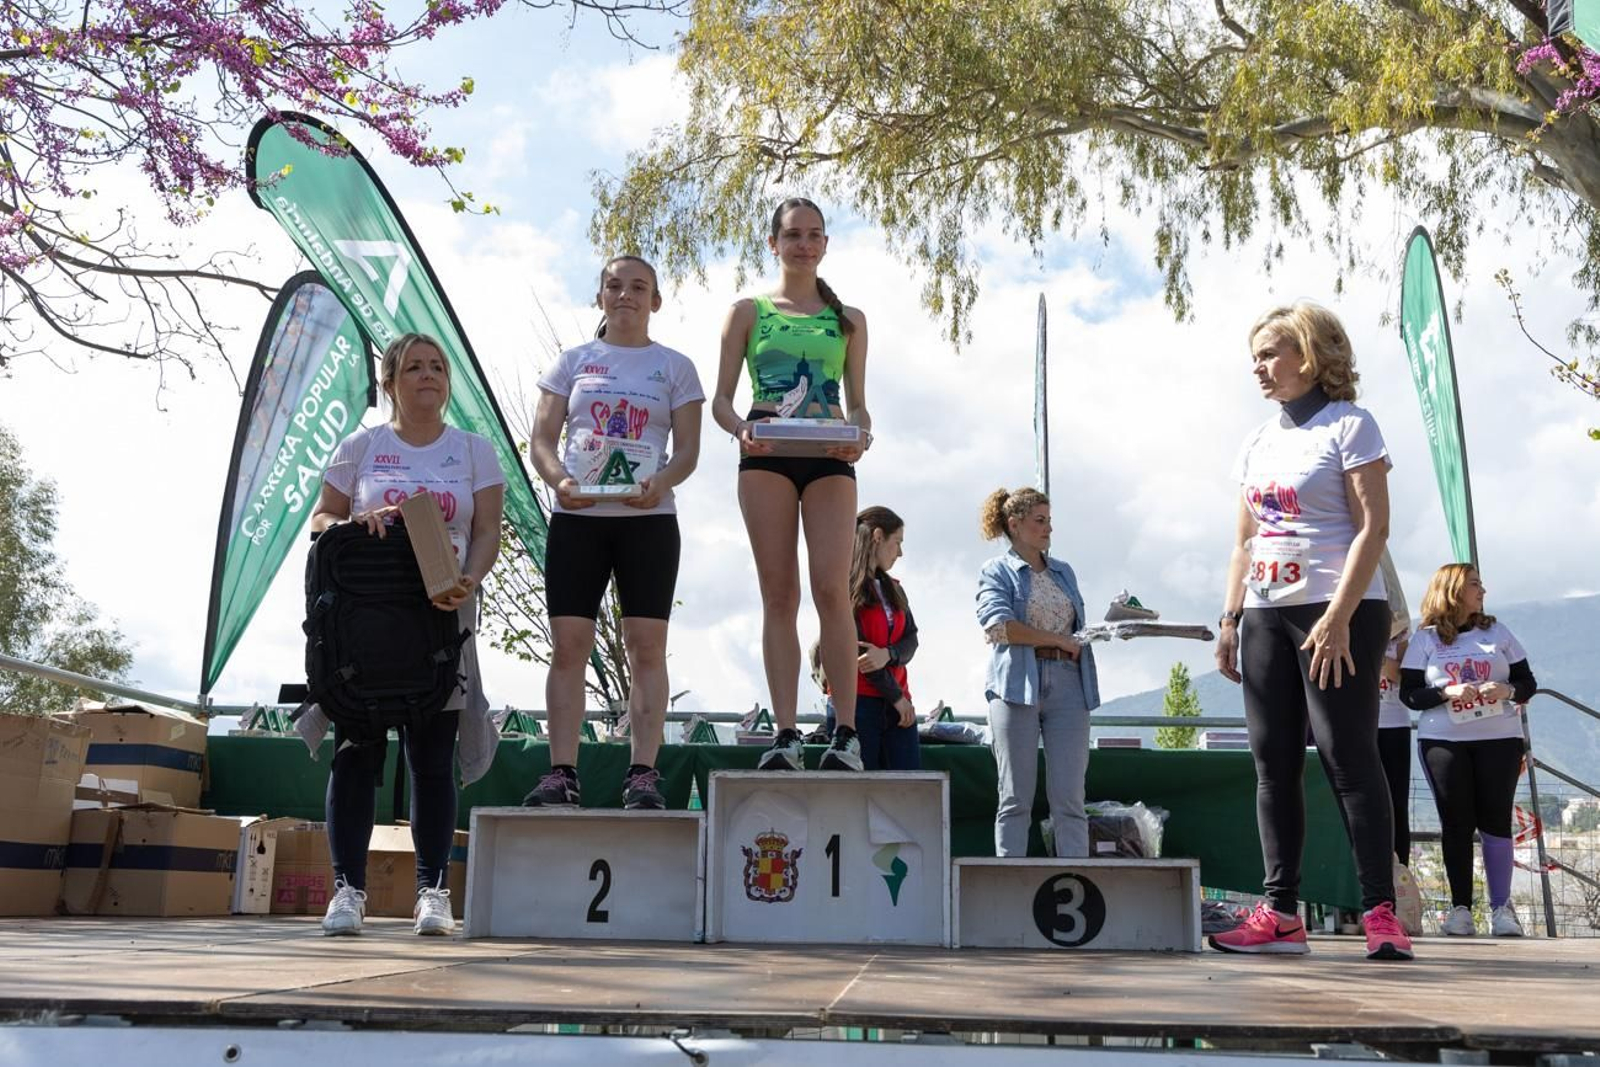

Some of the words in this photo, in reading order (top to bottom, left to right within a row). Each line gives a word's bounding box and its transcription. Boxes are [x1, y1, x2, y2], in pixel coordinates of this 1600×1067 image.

[241, 432, 303, 537] CARRERA
[294, 335, 351, 432] POPULAR
[252, 519, 272, 545] POR
[348, 353, 360, 368] LA
[284, 399, 348, 514] SALUD
[1250, 560, 1302, 584] 813
[586, 859, 612, 923] 2
[825, 834, 841, 897] 1
[1052, 876, 1087, 943] 3
